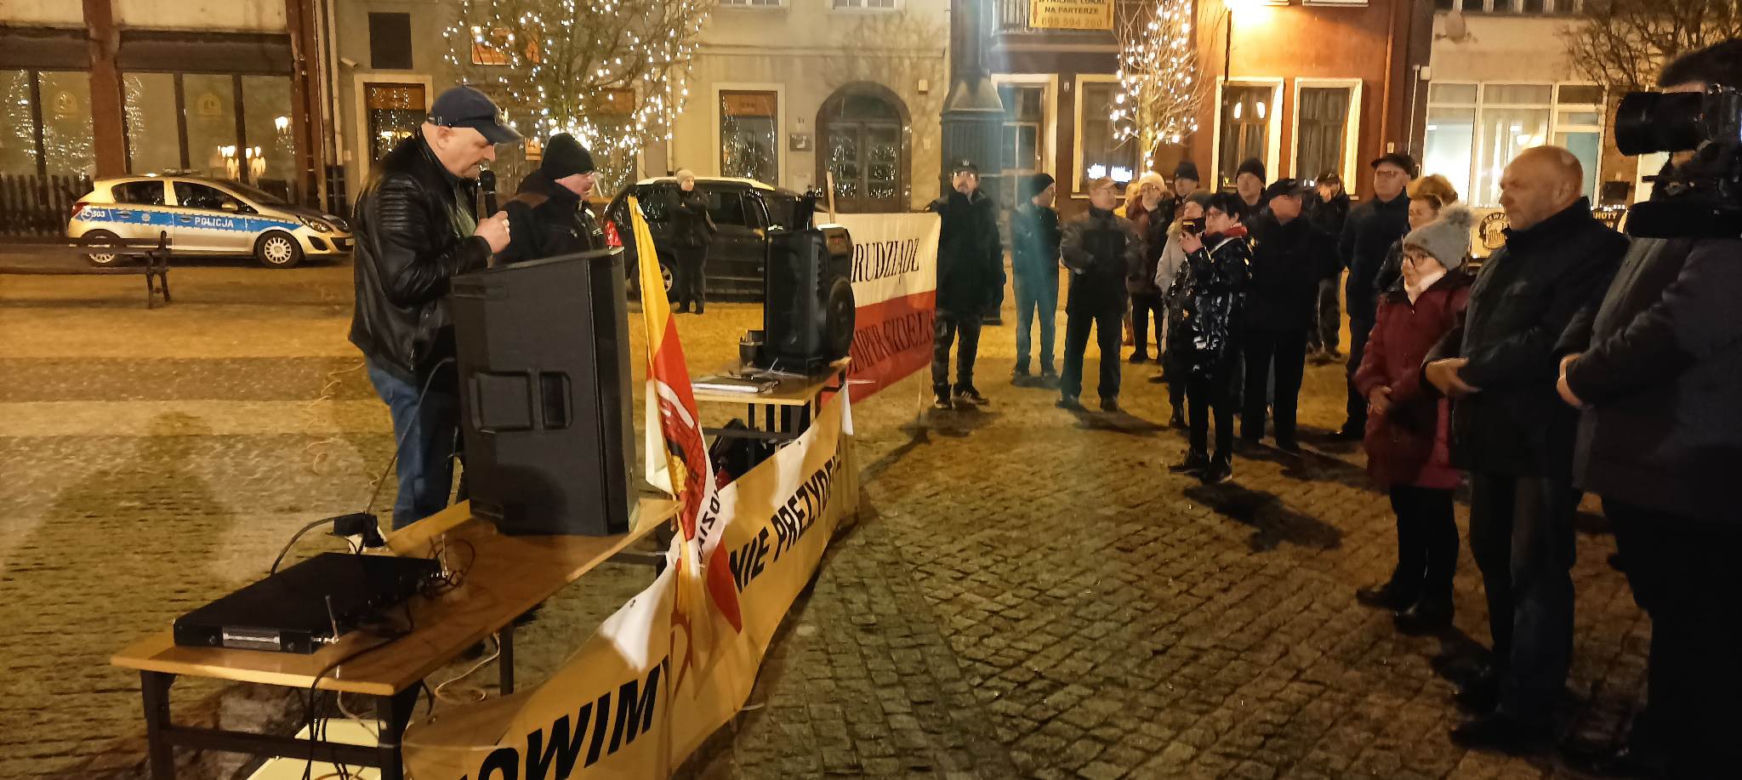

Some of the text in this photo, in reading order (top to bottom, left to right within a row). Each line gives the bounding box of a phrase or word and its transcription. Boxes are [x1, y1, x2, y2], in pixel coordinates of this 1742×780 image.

[1058, 6, 1099, 15] PARTERZE
[194, 216, 234, 228] POLICJA
[851, 238, 920, 284] RUDZIĄDZ
[882, 310, 935, 354] FIDELI
[453, 654, 670, 780] OWIM
[729, 526, 770, 594] NIE
